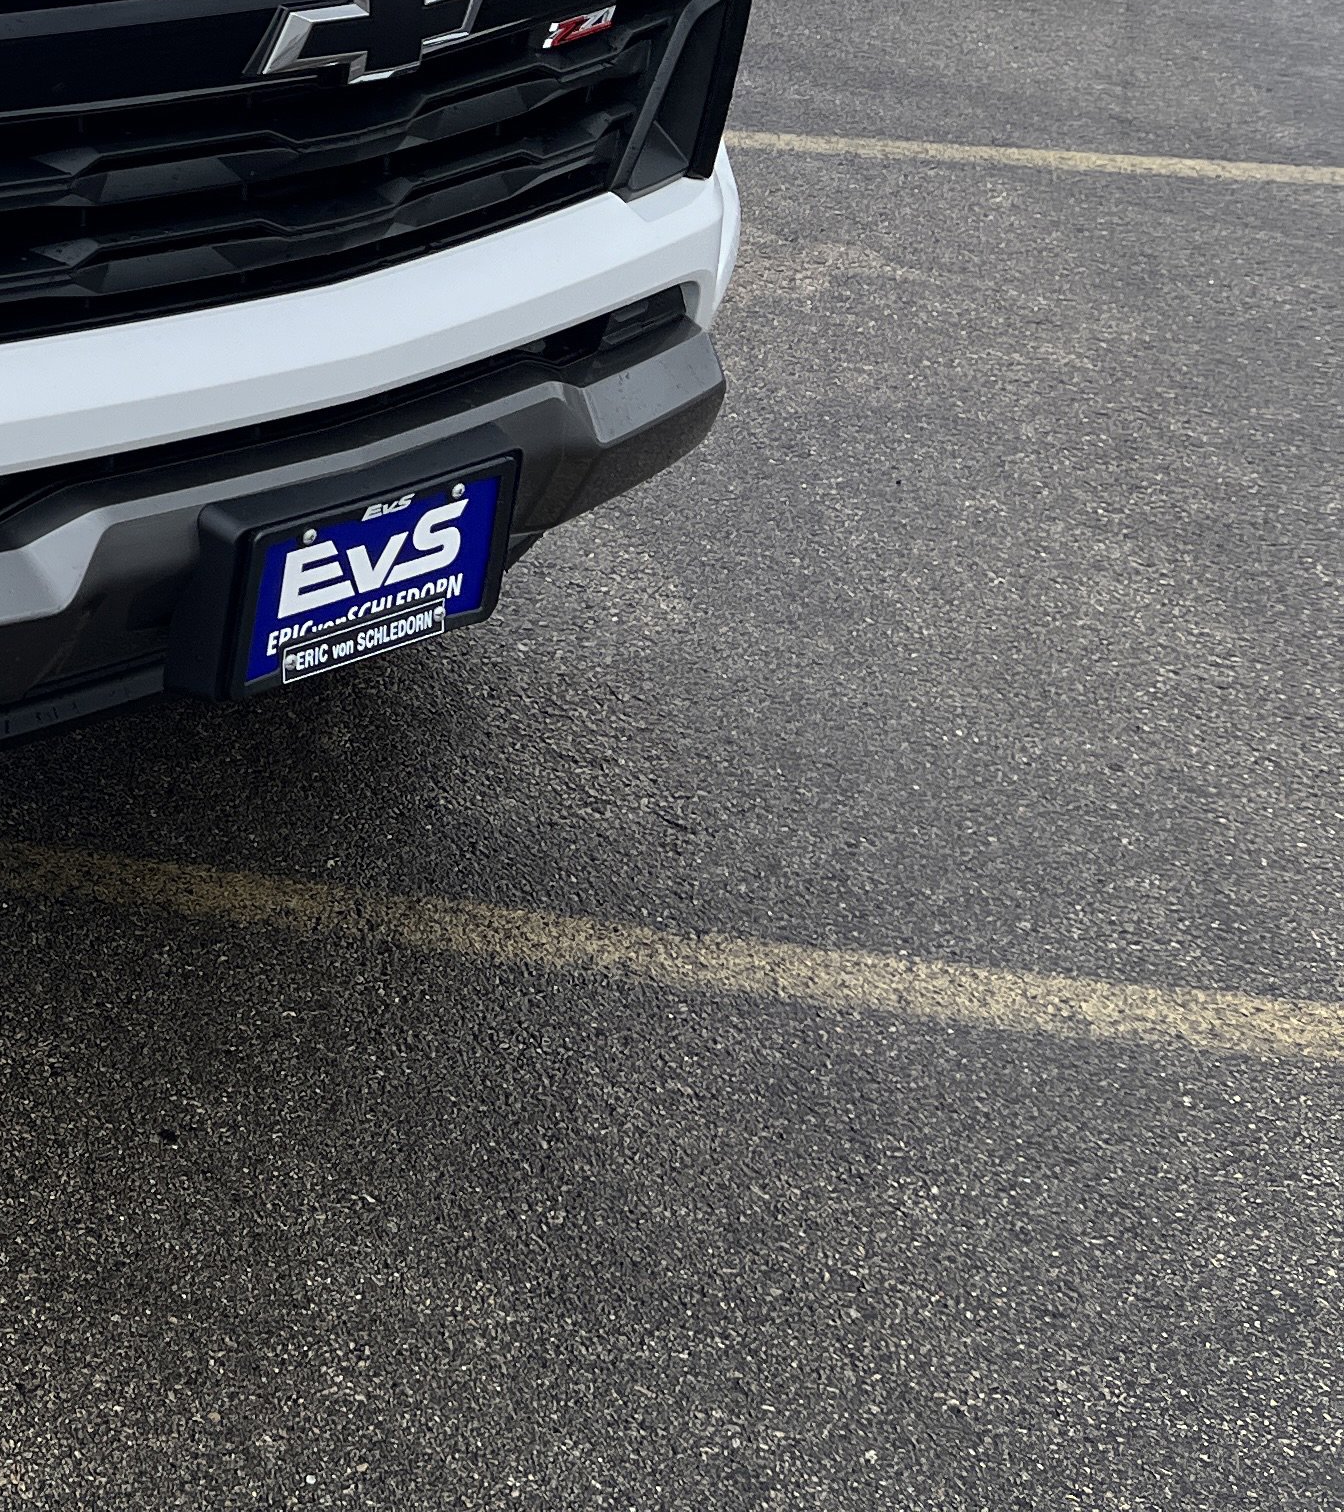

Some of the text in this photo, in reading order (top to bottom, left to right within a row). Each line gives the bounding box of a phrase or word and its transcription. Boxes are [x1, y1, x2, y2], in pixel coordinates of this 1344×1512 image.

[296, 643, 329, 670] ERIC
[332, 639, 354, 659] von
[357, 609, 432, 651] SCHLEDORN
